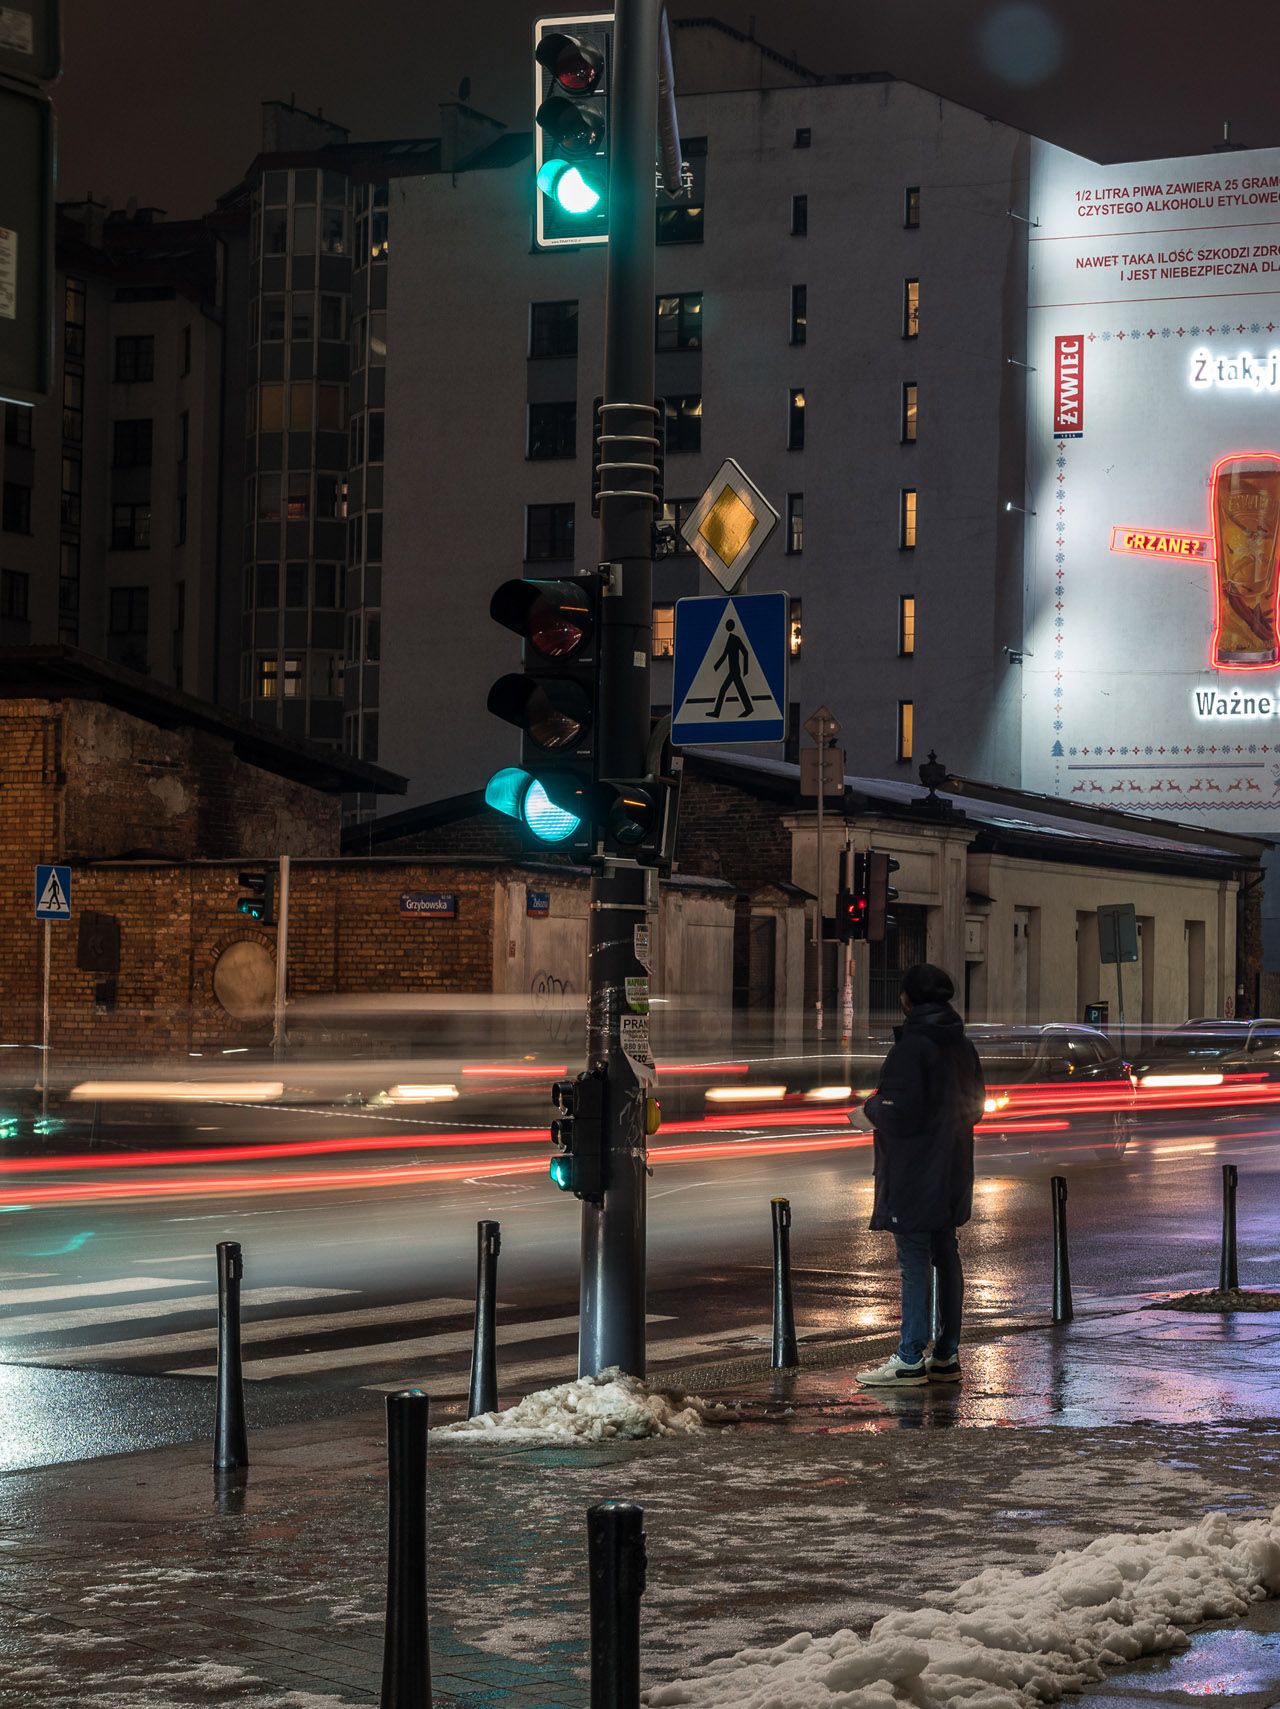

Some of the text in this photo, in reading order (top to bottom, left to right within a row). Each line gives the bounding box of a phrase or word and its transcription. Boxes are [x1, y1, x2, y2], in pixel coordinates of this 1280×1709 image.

[1076, 190, 1092, 202] 1/2
[1095, 187, 1130, 201] LITRA
[1132, 185, 1164, 198] PIWA
[1166, 181, 1222, 195] ZAWIERA
[1225, 179, 1239, 191] 25
[1078, 202, 1144, 217] CZYSTEGO
[1146, 197, 1214, 213] ALKOHOLU
[1076, 255, 1119, 269] NAWET
[1121, 253, 1155, 266] TAKA
[1158, 249, 1194, 264] ILOŚĆ
[1197, 246, 1249, 261] SZKODZI
[1120, 270, 1124, 281] I
[1126, 268, 1158, 282] JEST
[1160, 261, 1258, 280] NIEBEZPIECZNA
[1057, 340, 1079, 425] ŻYWIEC
[1217, 357, 1261, 387] tak,
[1123, 533, 1200, 555] GRZANE?
[1195, 691, 1271, 716] Ważne
[406, 899, 447, 912] Grzybowska
